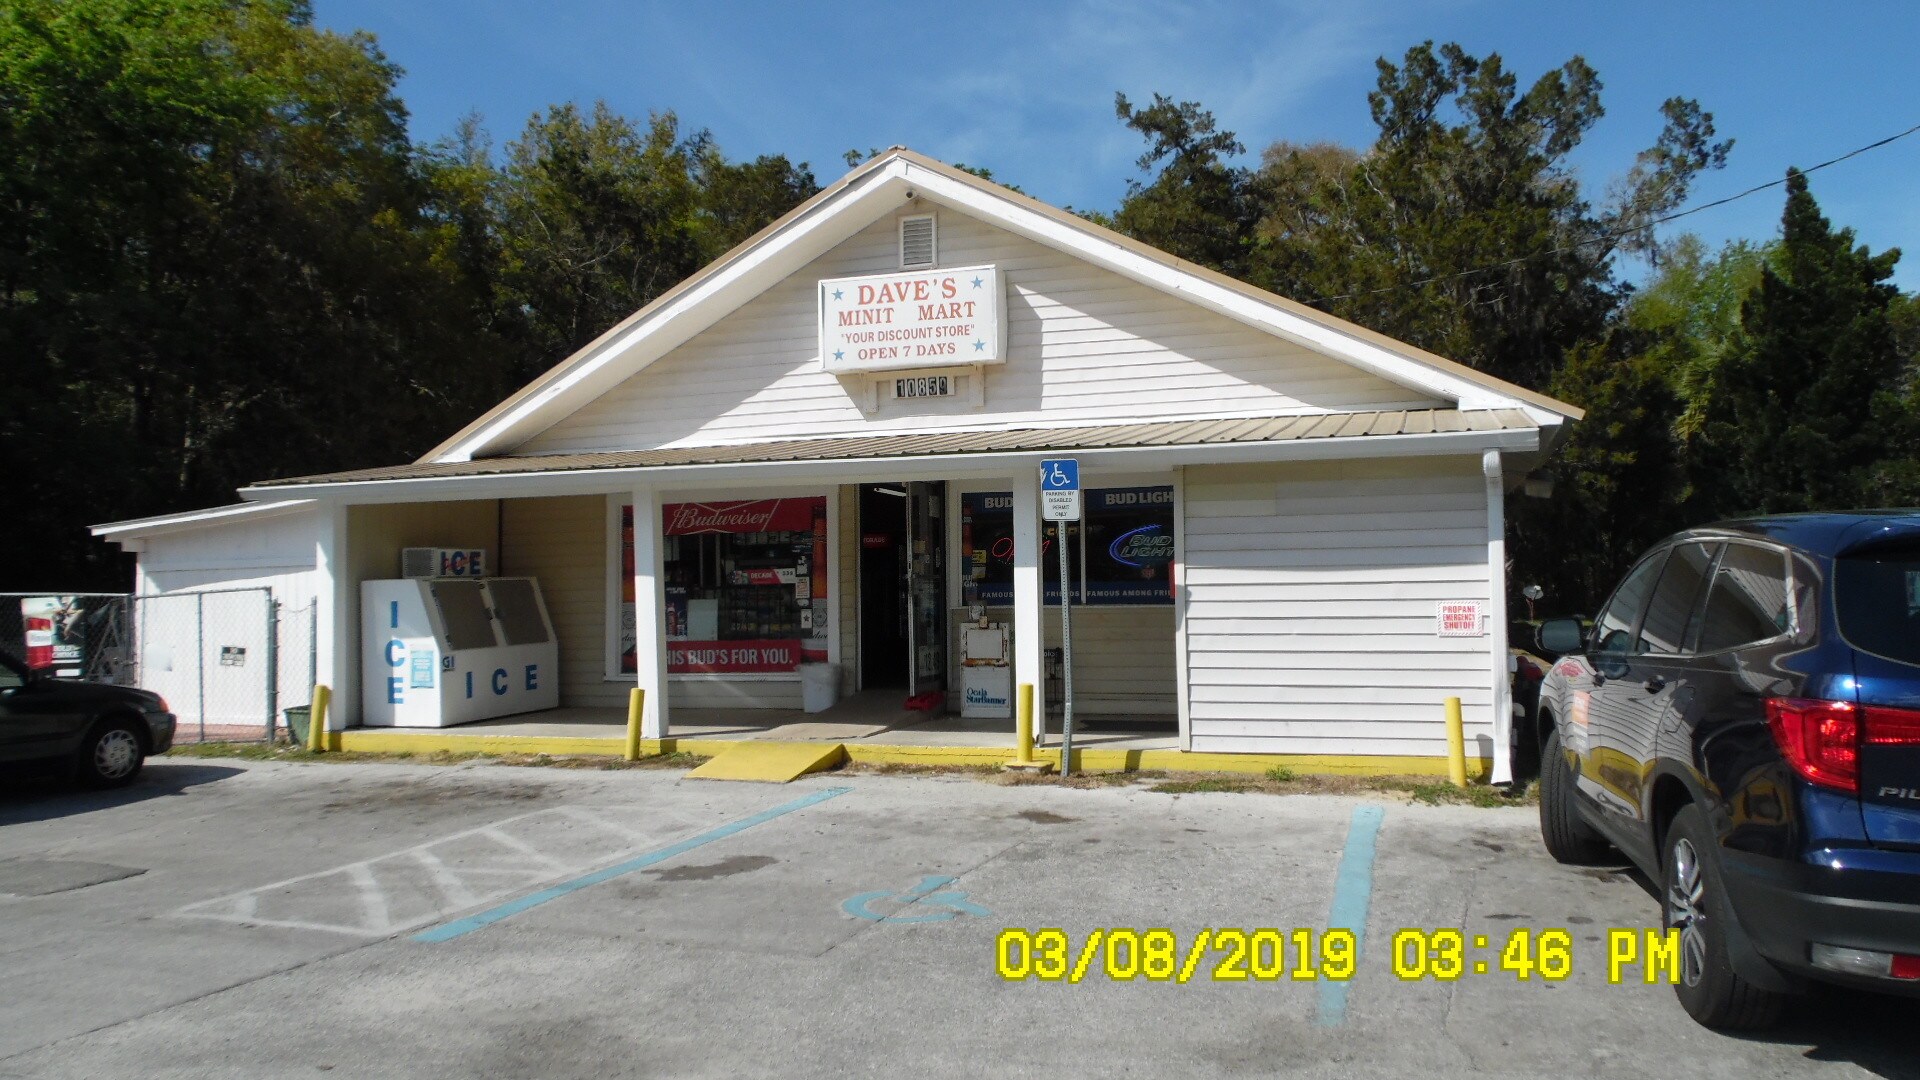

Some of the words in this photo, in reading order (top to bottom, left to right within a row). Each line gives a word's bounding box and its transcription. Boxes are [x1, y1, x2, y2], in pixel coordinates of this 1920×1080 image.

[858, 277, 957, 305] DAVE'S
[838, 308, 894, 326] MINIT
[918, 301, 976, 321] MART
[878, 327, 933, 341] DISCOUNT
[935, 324, 975, 338] STORE"
[858, 347, 898, 360] OPEN
[903, 345, 911, 357] 7
[916, 342, 956, 356] DAYS
[897, 376, 948, 397] 10859
[985, 498, 1013, 508] BUD
[1105, 493, 1137, 505] BUD
[1140, 491, 1174, 503] LIGH
[673, 508, 771, 529] Budweiser
[1129, 534, 1172, 546] BUD
[1121, 546, 1174, 558] LIGHT
[440, 551, 481, 576] ICE
[1442, 605, 1475, 613] PROPANE
[385, 601, 405, 704] ICE
[667, 651, 685, 666] HIS
[688, 649, 729, 666] BUD'S
[731, 649, 757, 665] FOR
[762, 648, 792, 665] YOU.
[466, 664, 538, 699] ICE
[967, 687, 987, 696] Ocala
